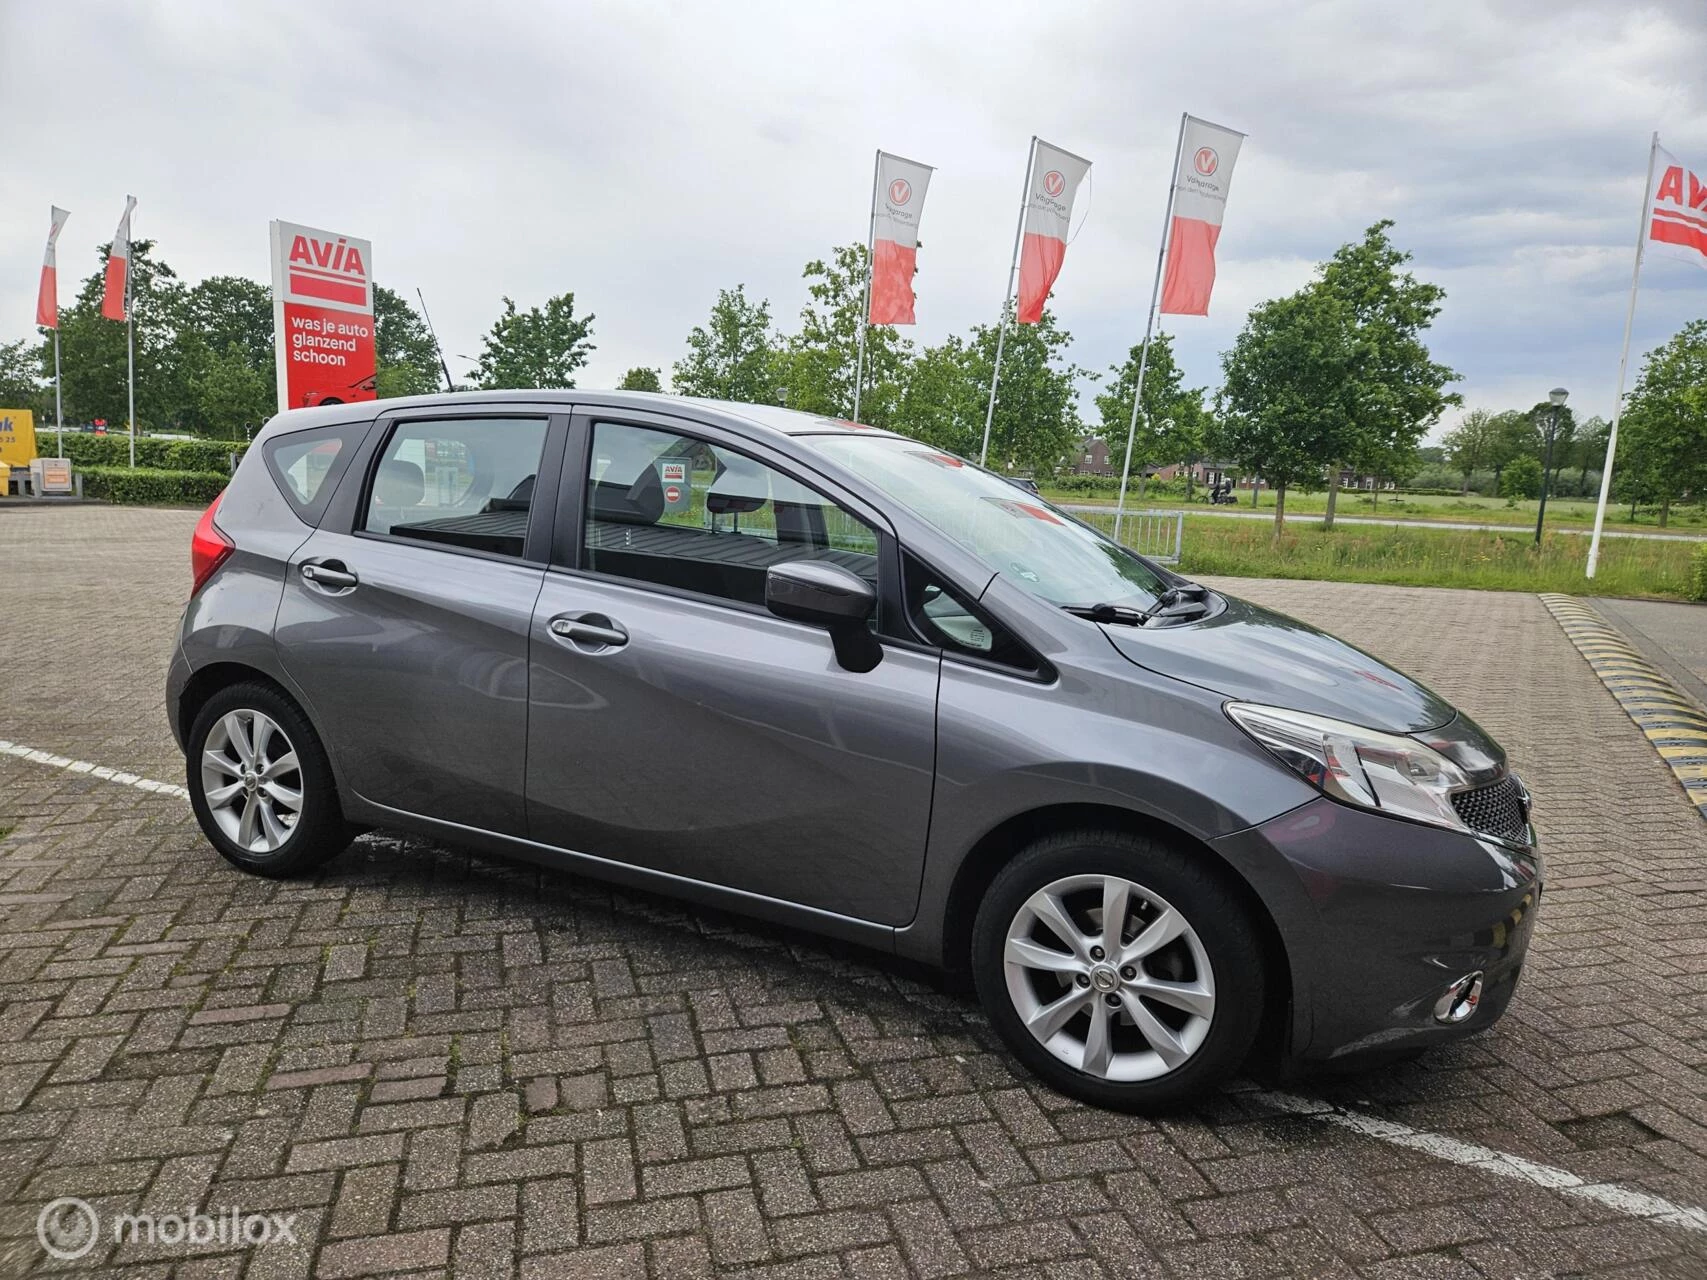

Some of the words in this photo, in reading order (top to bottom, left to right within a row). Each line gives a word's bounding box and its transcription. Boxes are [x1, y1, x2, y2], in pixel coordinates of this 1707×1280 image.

[1656, 165, 1707, 213] AV
[292, 316, 320, 330] was
[321, 318, 335, 335] je
[338, 322, 369, 338] auto
[292, 332, 357, 352] glanzend
[293, 350, 346, 367] schoon
